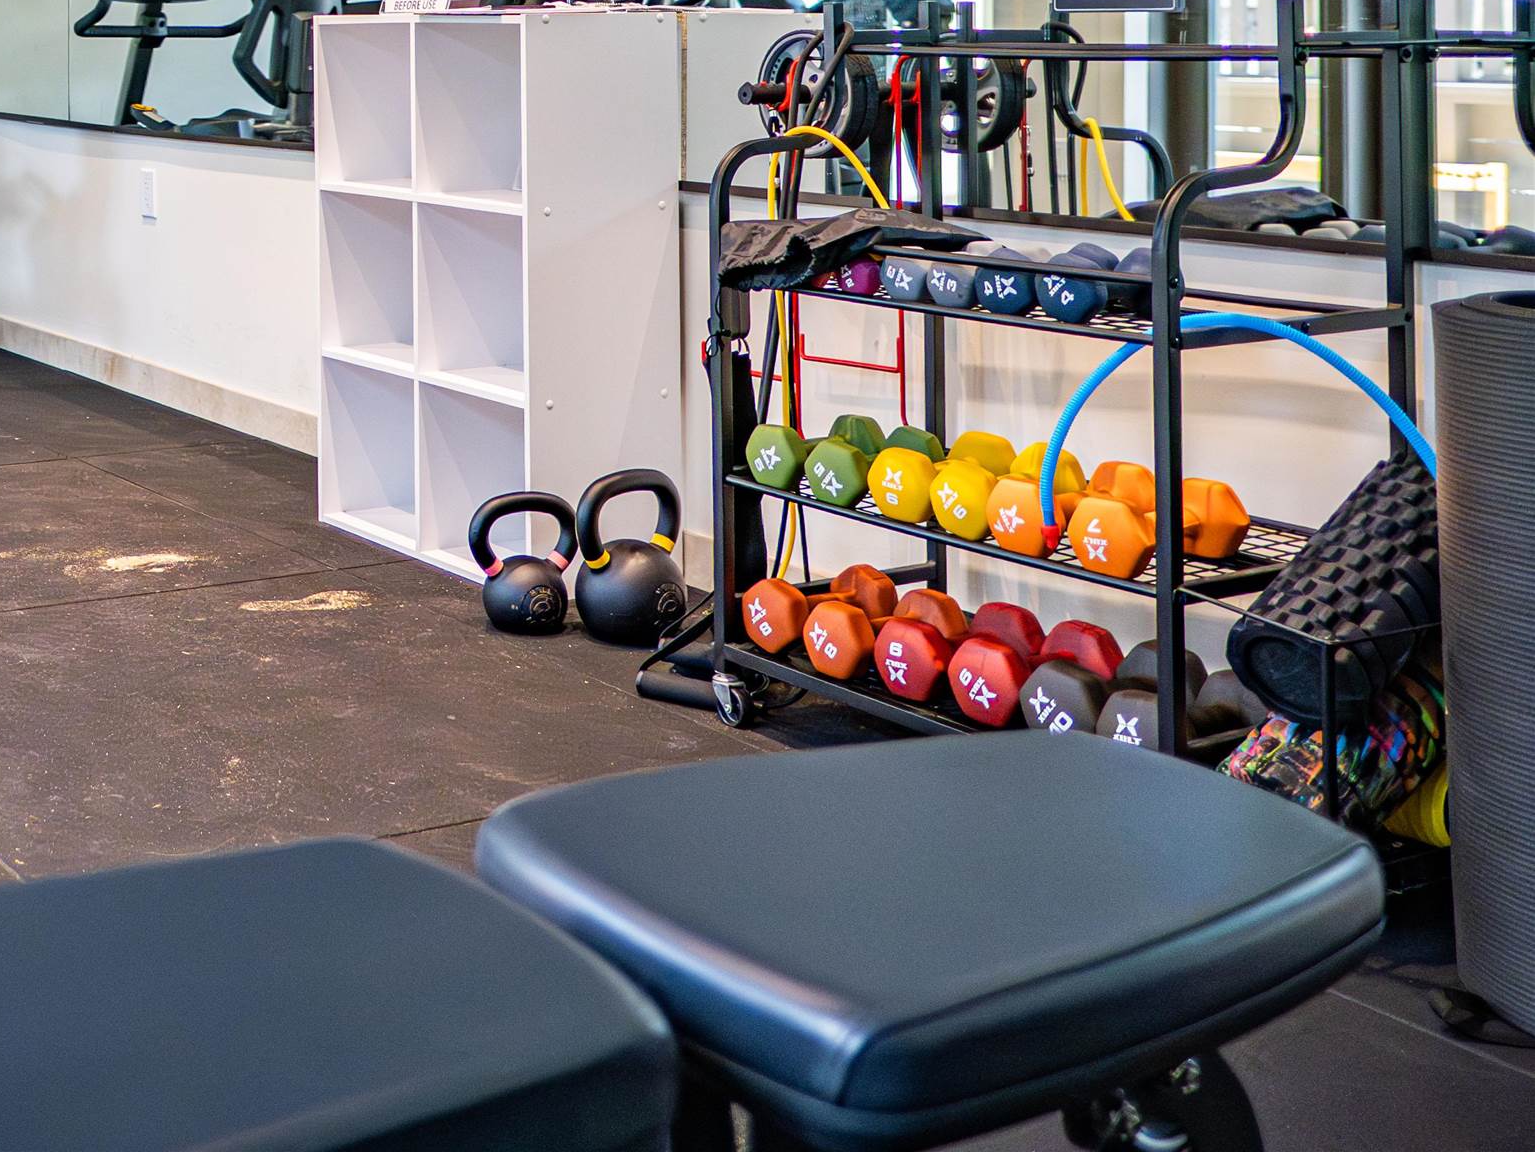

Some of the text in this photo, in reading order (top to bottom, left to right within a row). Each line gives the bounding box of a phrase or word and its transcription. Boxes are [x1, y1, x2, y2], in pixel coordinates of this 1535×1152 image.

[394, 0, 437, 10] BEFORE USE
[984, 280, 994, 296] 4
[1061, 290, 1074, 305] 4
[1087, 518, 1101, 533] 7
[759, 621, 773, 637] 8
[824, 642, 838, 659] 8
[1113, 733, 1143, 746] XULT
